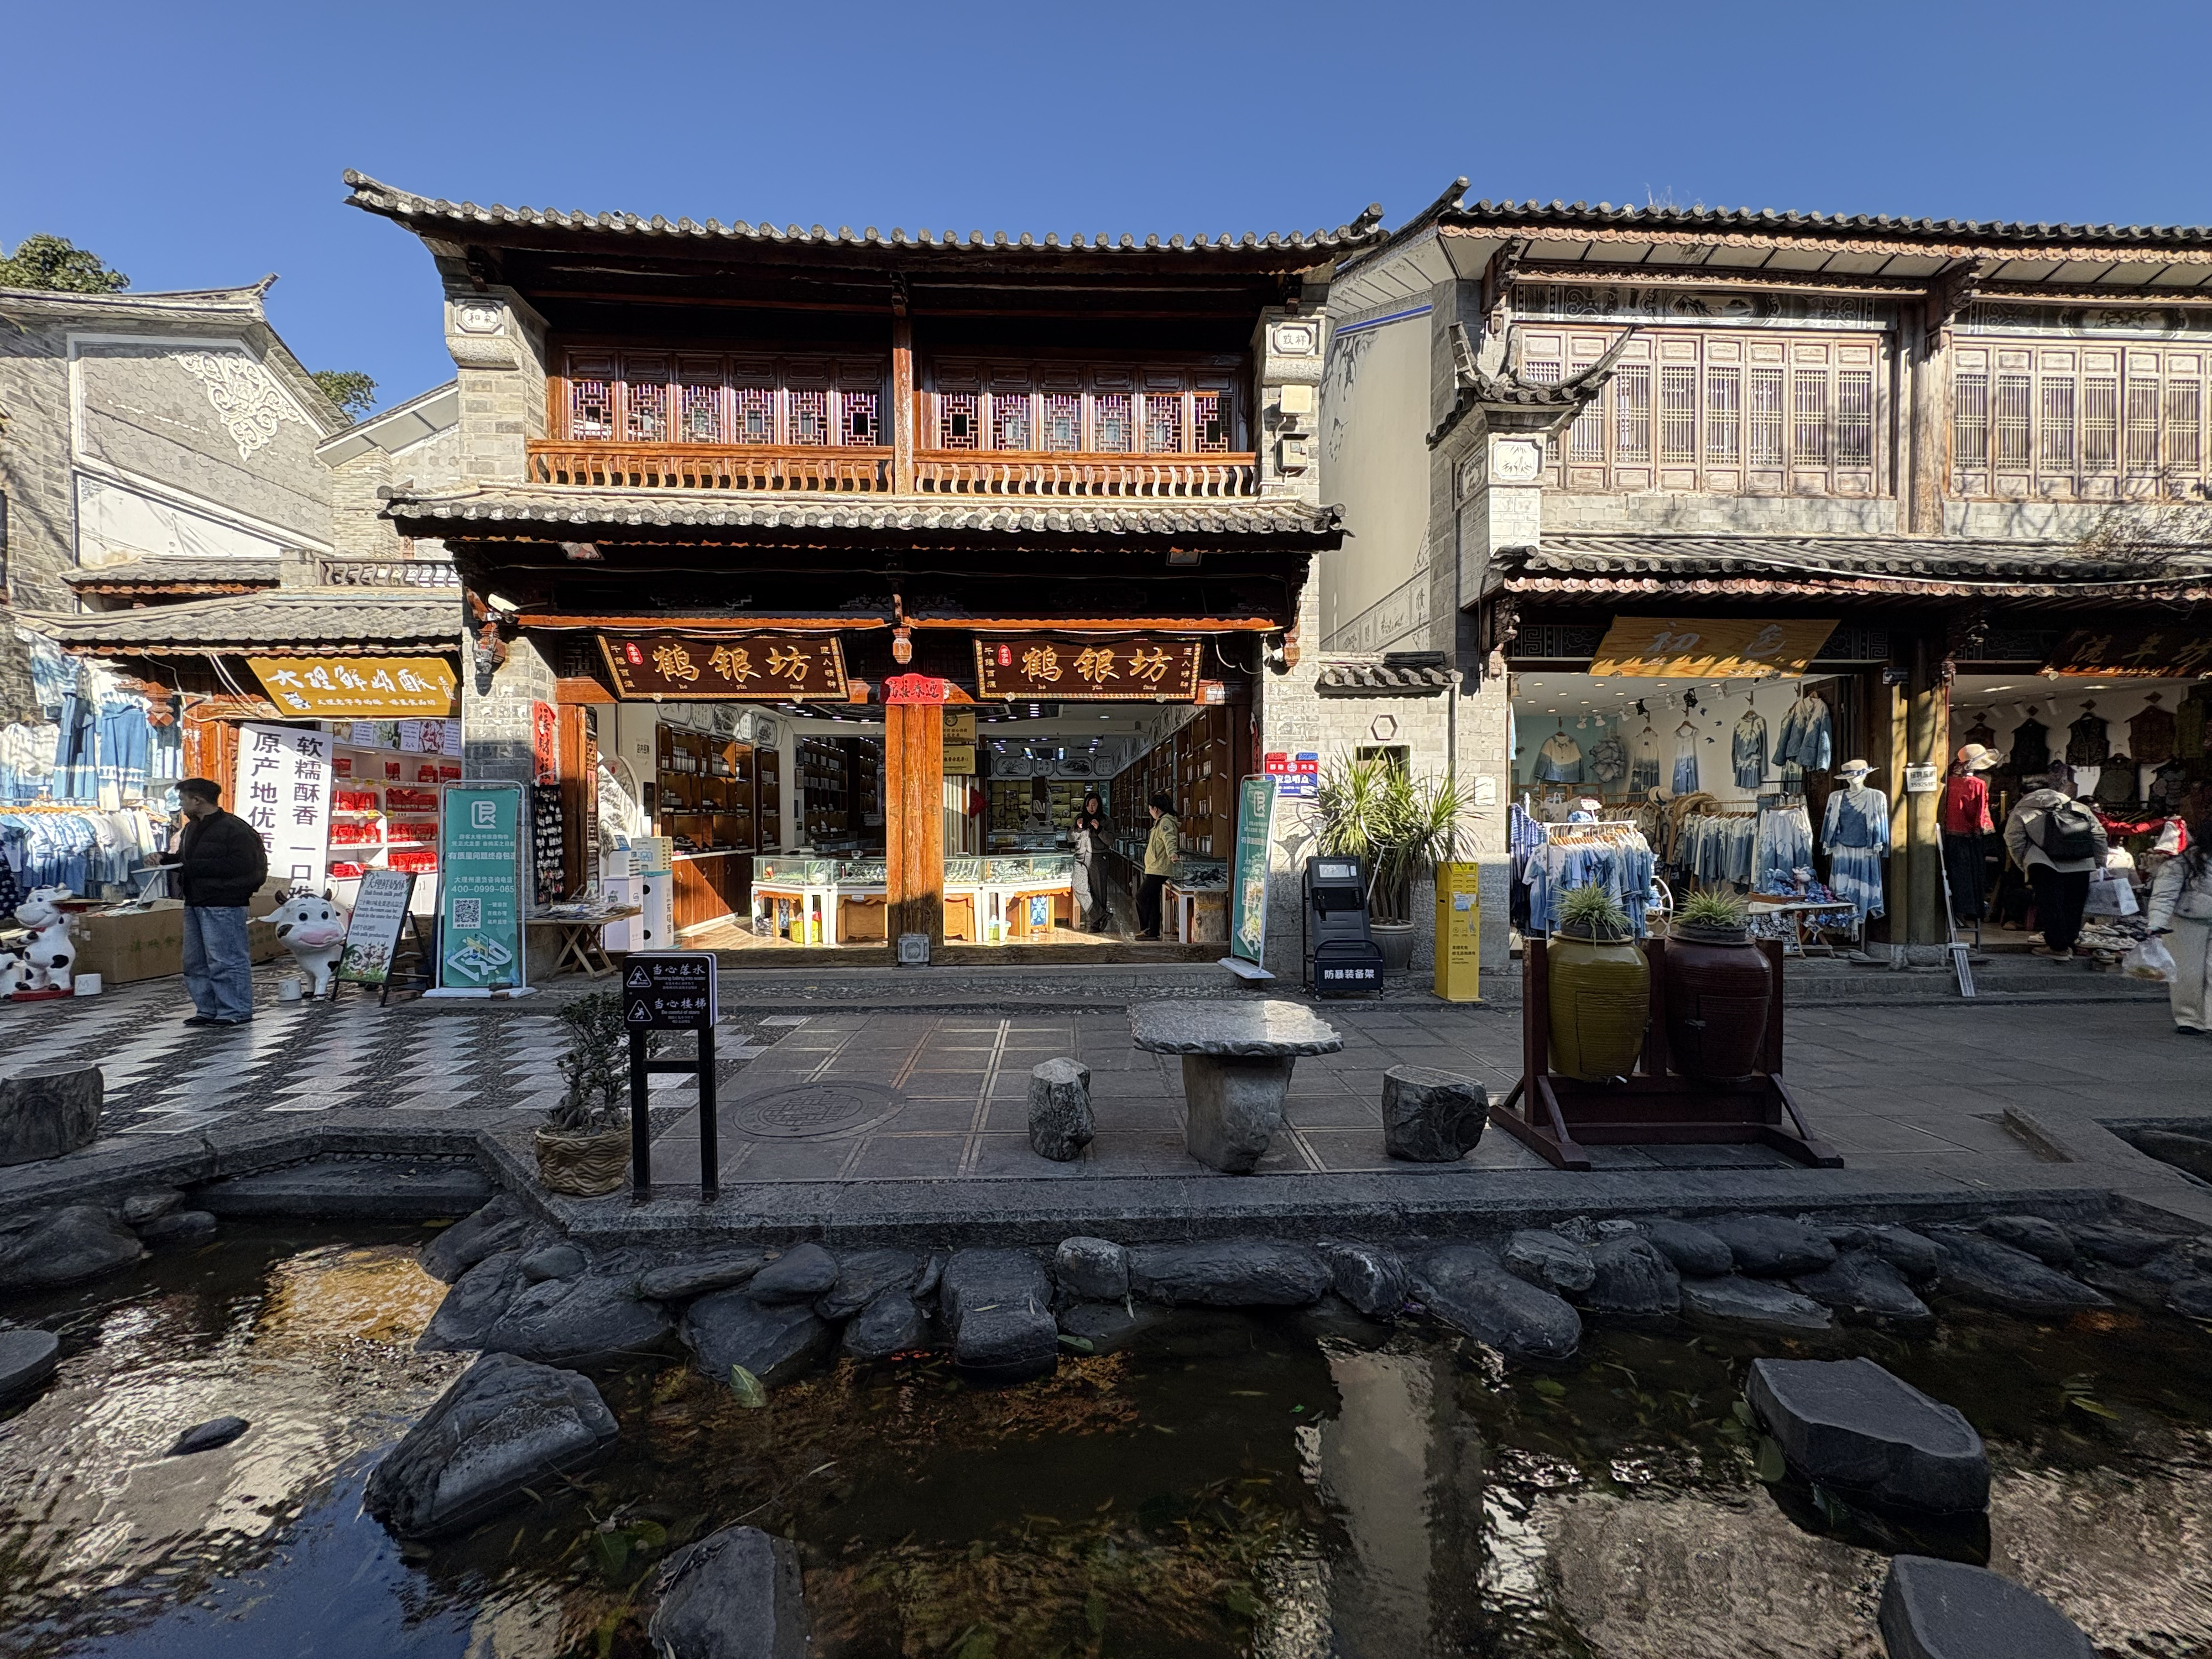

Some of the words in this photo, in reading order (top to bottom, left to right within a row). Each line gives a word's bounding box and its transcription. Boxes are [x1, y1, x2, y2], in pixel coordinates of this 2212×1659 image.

[266, 665, 436, 693] 大理鲜奶酥
[292, 736, 324, 826] 软糯酥香
[248, 732, 281, 872] 原产地优质
[653, 963, 706, 975] 当心落水
[1324, 969, 1375, 979] 防暴装备架
[654, 998, 707, 1010] 当心楼梯
